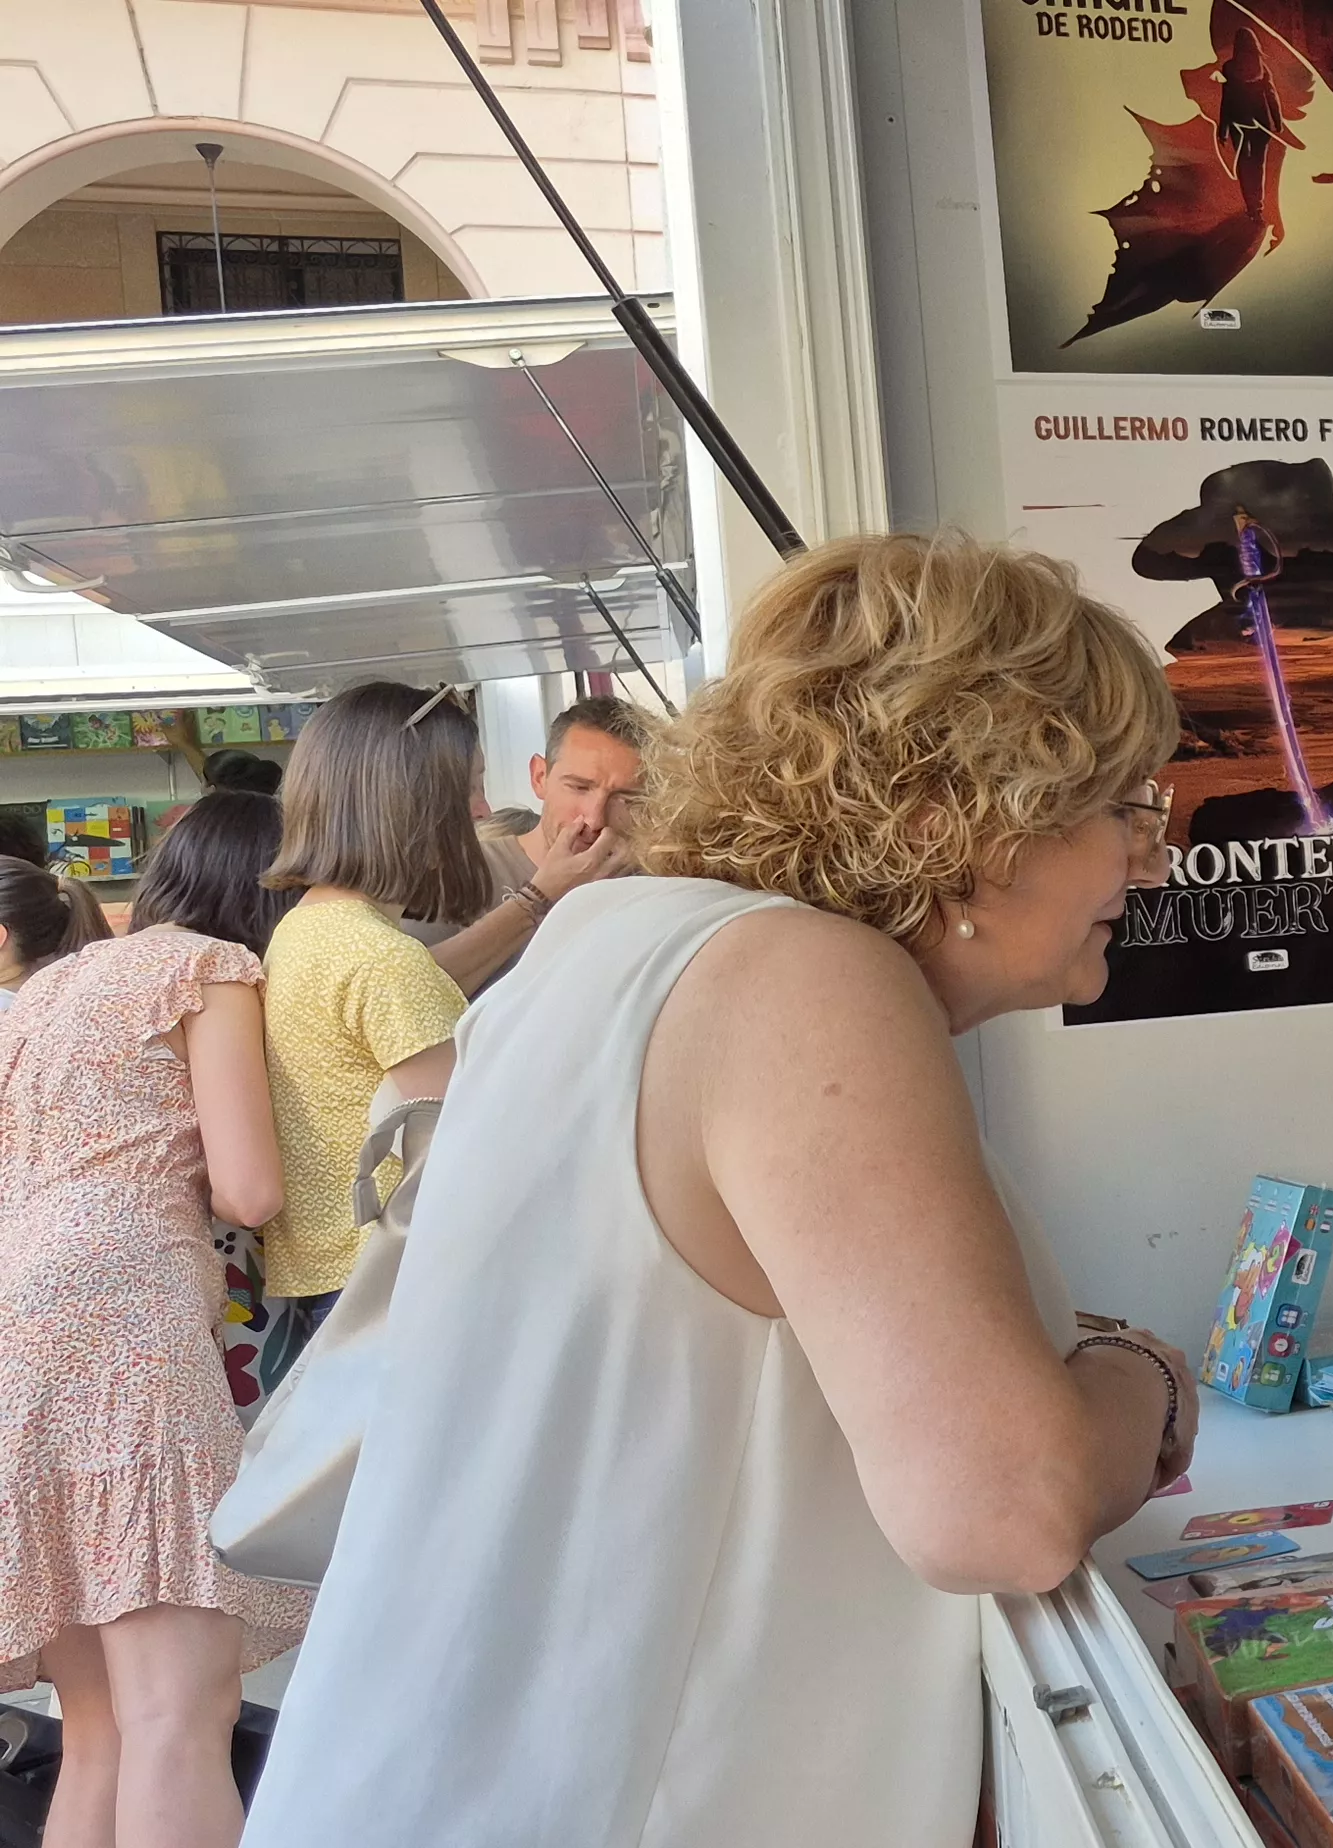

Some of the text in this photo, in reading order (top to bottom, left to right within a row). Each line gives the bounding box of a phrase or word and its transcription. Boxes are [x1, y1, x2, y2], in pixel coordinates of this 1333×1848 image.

[1036, 12, 1173, 43] DE RODENO
[1035, 415, 1188, 441] GUILLERMO
[1200, 417, 1309, 442] ROMERO
